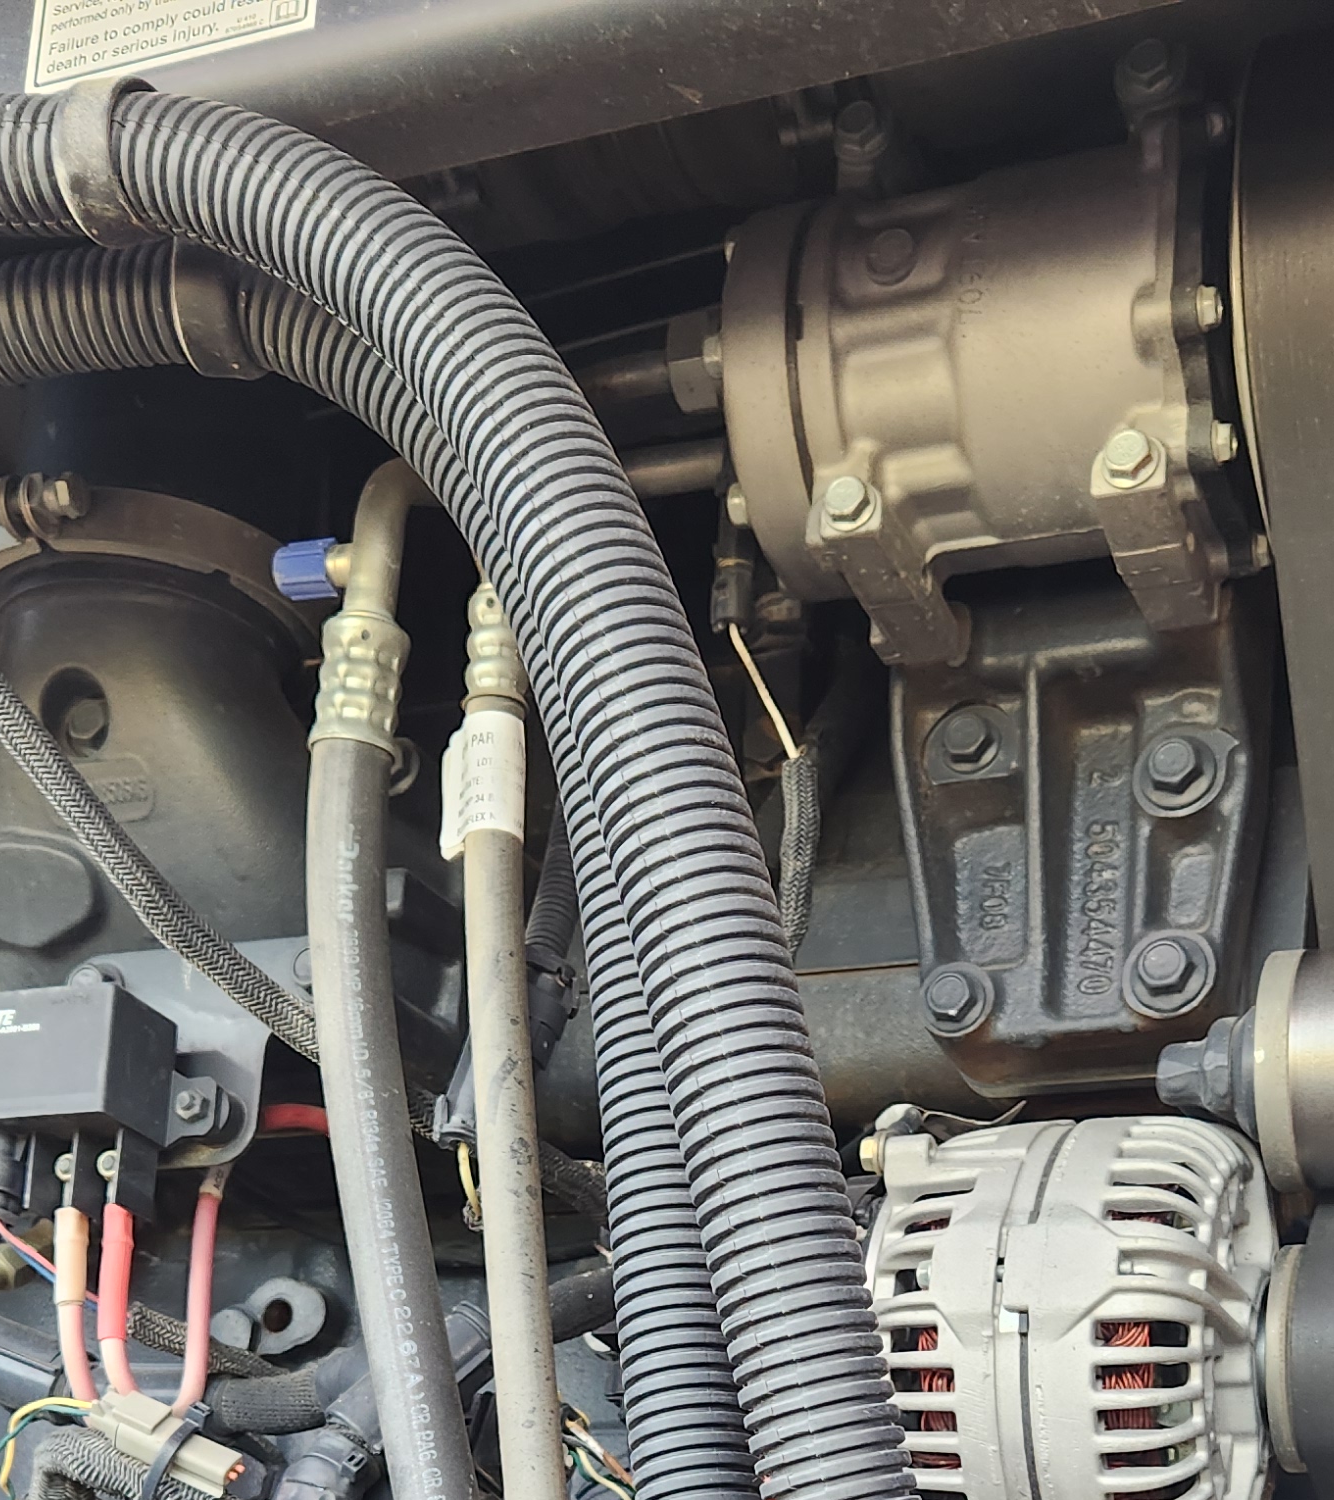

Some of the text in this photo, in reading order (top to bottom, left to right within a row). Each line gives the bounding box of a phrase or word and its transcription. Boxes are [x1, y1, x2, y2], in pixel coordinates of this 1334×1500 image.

[48, 34, 99, 56] Failure
[104, 29, 118, 42] to
[122, 13, 178, 38] comply
[183, 0, 225, 22] could
[51, 0, 150, 34] performed only by
[46, 21, 219, 74] death or serious injury.
[368, 1157, 388, 1189] SAE
[381, 1242, 405, 1288] TYPE
[389, 1288, 407, 1301] C
